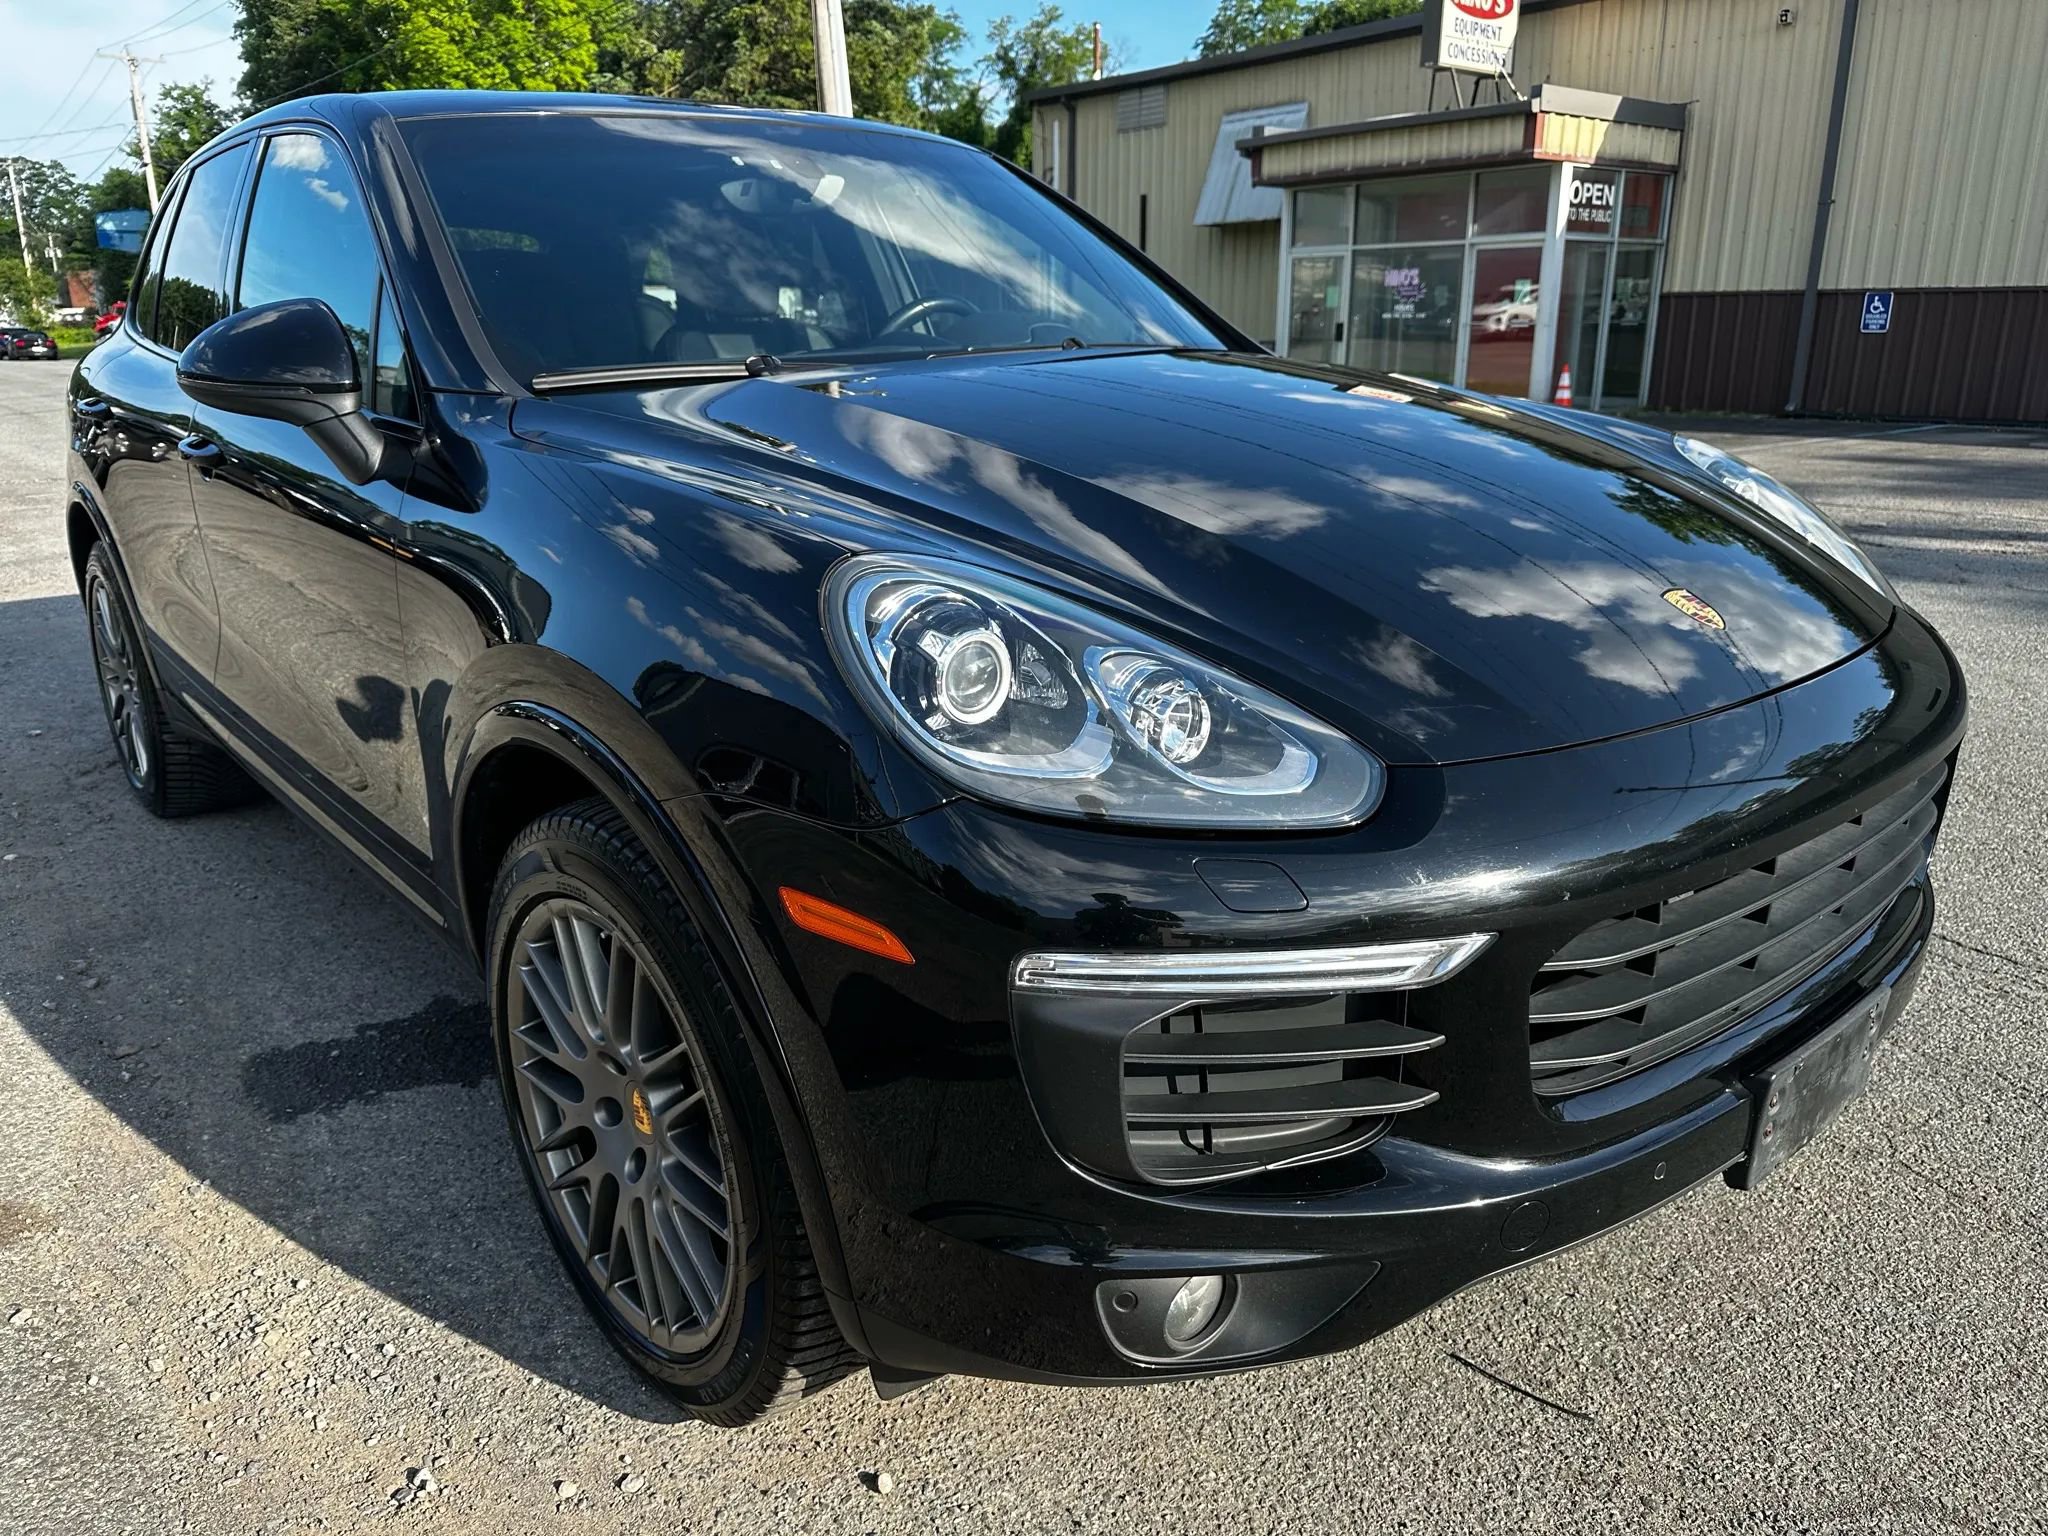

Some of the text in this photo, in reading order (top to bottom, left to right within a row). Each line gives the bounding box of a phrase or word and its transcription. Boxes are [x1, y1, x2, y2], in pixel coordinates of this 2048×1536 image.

[1454, 17, 1502, 41] EQUIPMENT
[1569, 180, 1616, 206] OPEN
[1578, 208, 1590, 222] THE
[1590, 209, 1612, 223] PUBLIC
